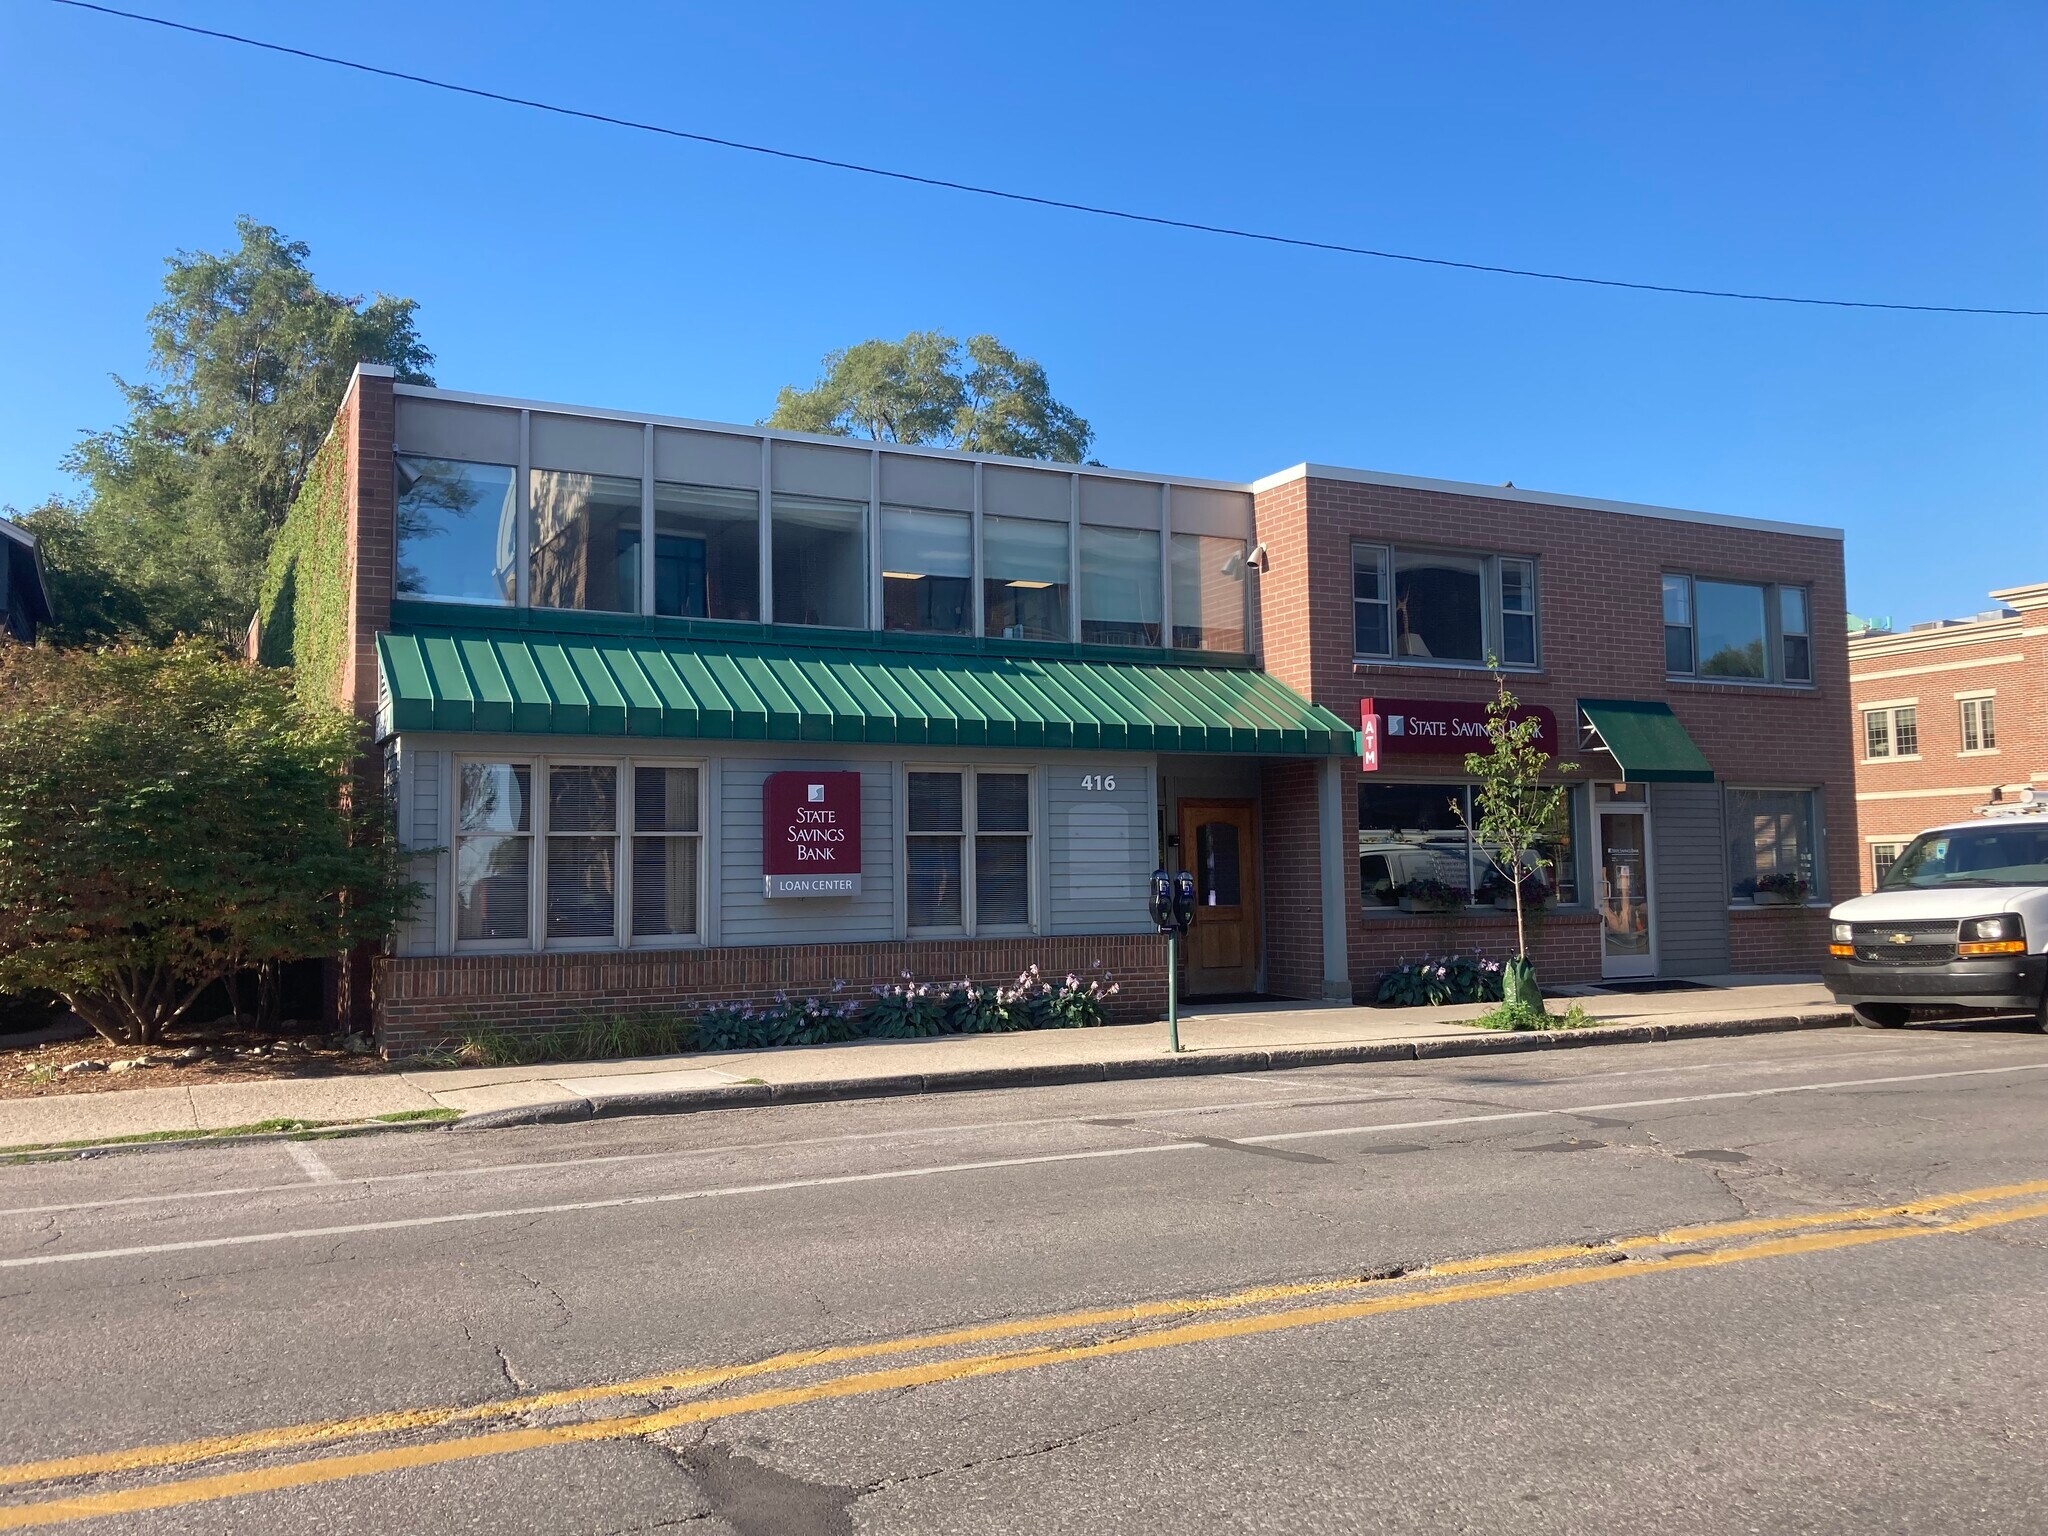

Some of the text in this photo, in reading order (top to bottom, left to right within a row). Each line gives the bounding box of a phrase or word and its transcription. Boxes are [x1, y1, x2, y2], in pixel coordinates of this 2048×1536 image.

[1408, 716, 1448, 736] STATE
[1364, 720, 1376, 765] ATM
[1081, 774, 1116, 791] 416
[796, 807, 837, 823] STATE
[787, 825, 845, 842] SAVINGS
[797, 844, 836, 861] BANK
[780, 880, 852, 891] LOAN CENTER
